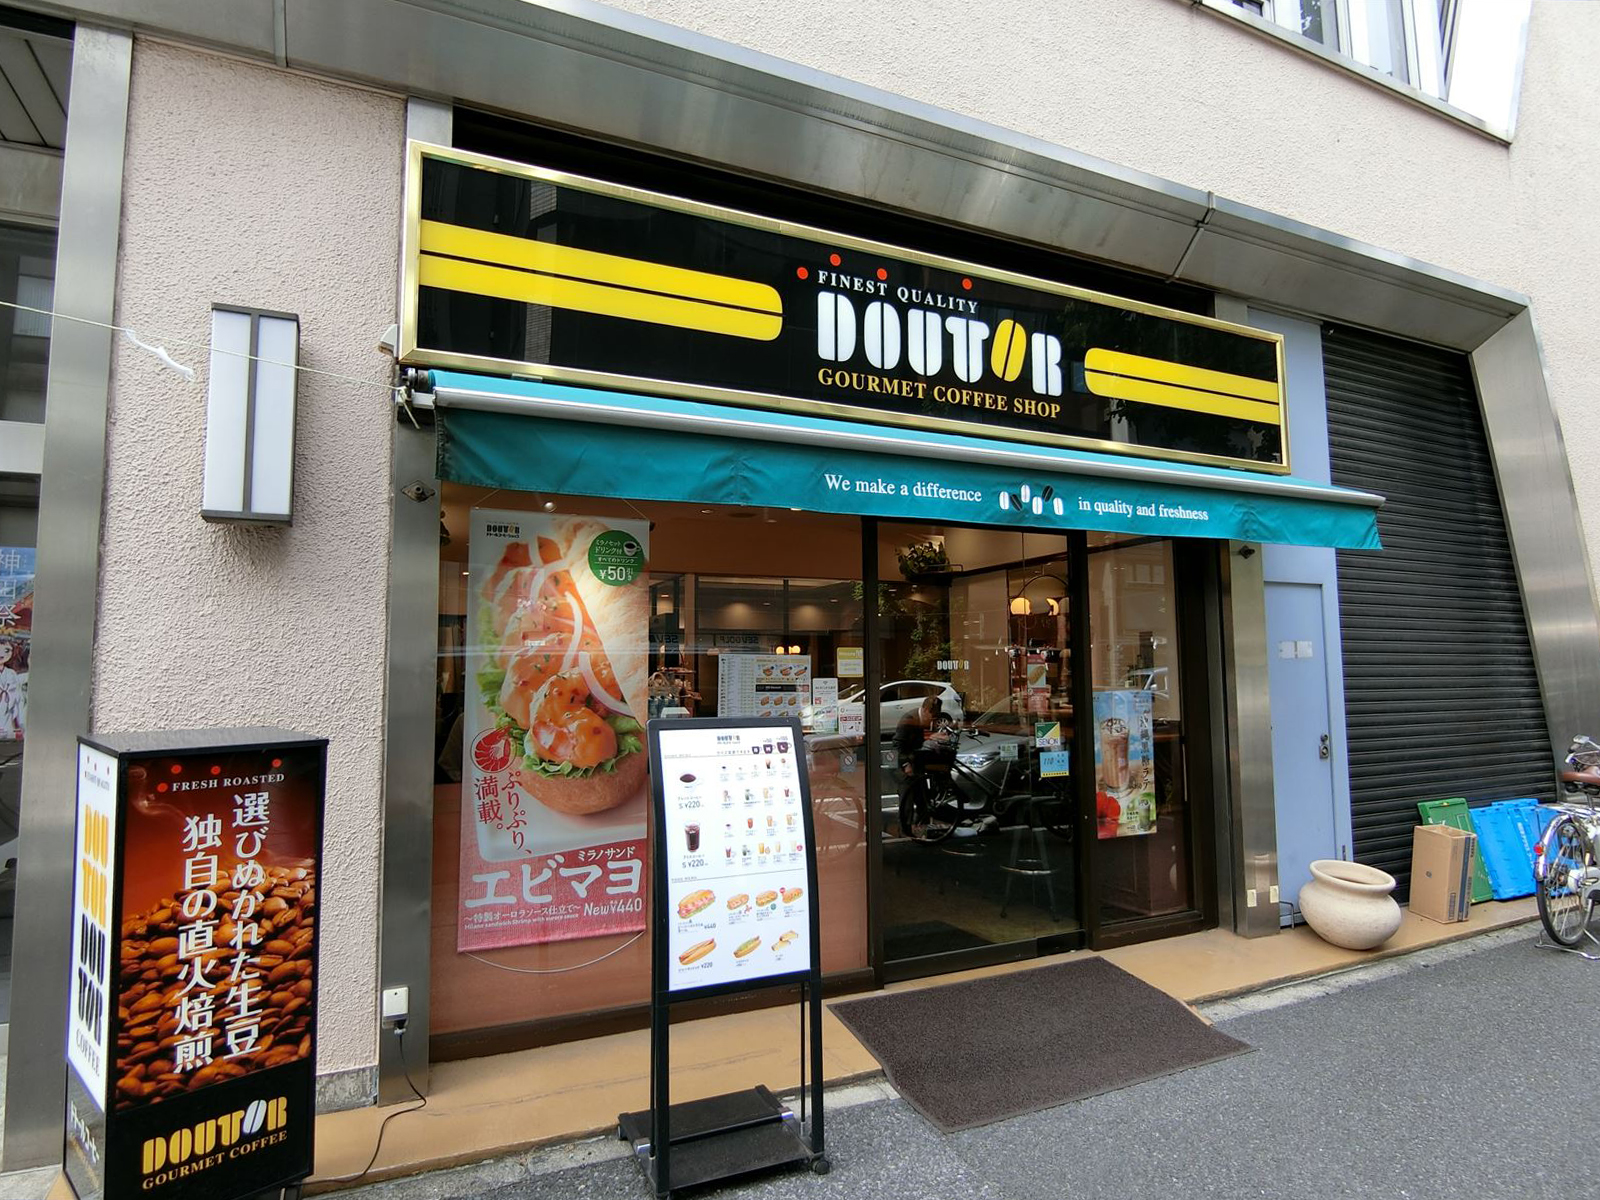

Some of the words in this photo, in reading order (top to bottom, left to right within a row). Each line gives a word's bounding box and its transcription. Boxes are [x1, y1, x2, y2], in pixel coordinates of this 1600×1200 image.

[818, 270, 887, 296] FINEST
[897, 287, 979, 314] QUALITY
[817, 291, 1063, 397] DOUTOR
[818, 368, 927, 399] GOURMET
[933, 385, 1008, 412] COFFEE
[1014, 398, 1061, 419] SHOP
[824, 474, 851, 491] We
[856, 479, 896, 494] make
[900, 484, 909, 496] a
[913, 482, 982, 502] difference
[1078, 496, 1091, 510] in
[1094, 500, 1133, 518] quality
[1136, 504, 1155, 516] and
[1159, 504, 1209, 520] freshness
[600, 566, 626, 581] ¥50
[936, 660, 970, 671] DOUTOR
[172, 778, 218, 792] FRESH
[223, 773, 285, 788] ROASTED
[685, 800, 701, 809] ¥220
[578, 846, 636, 862] ミラノサンド
[688, 858, 705, 868] ¥220
[465, 854, 642, 908] エビマヨ
[173, 813, 223, 1074] 独自の直火焙煎
[223, 791, 270, 1060] 選びぬかれた生豆
[76, 1028, 100, 1077] COFFEE
[142, 1096, 288, 1174] DOUTOR
[142, 1152, 225, 1190] GOURMET
[229, 1130, 288, 1160] COFFEE
